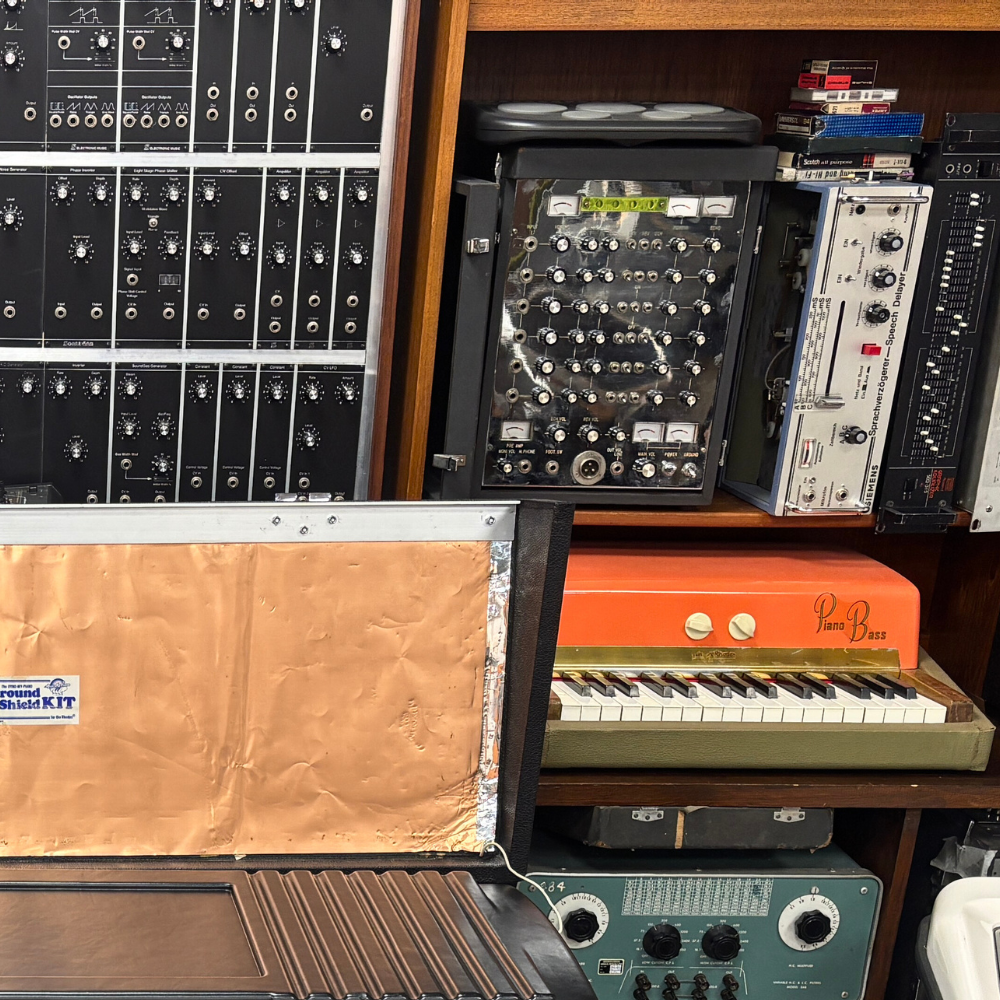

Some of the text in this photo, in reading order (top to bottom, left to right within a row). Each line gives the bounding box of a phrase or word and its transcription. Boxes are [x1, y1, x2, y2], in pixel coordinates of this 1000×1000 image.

[886, 311, 899, 347] Speech
[893, 272, 906, 307] Delayer
[814, 592, 887, 644] Piano Bass
[0, 697, 76, 710] Shield KIT
